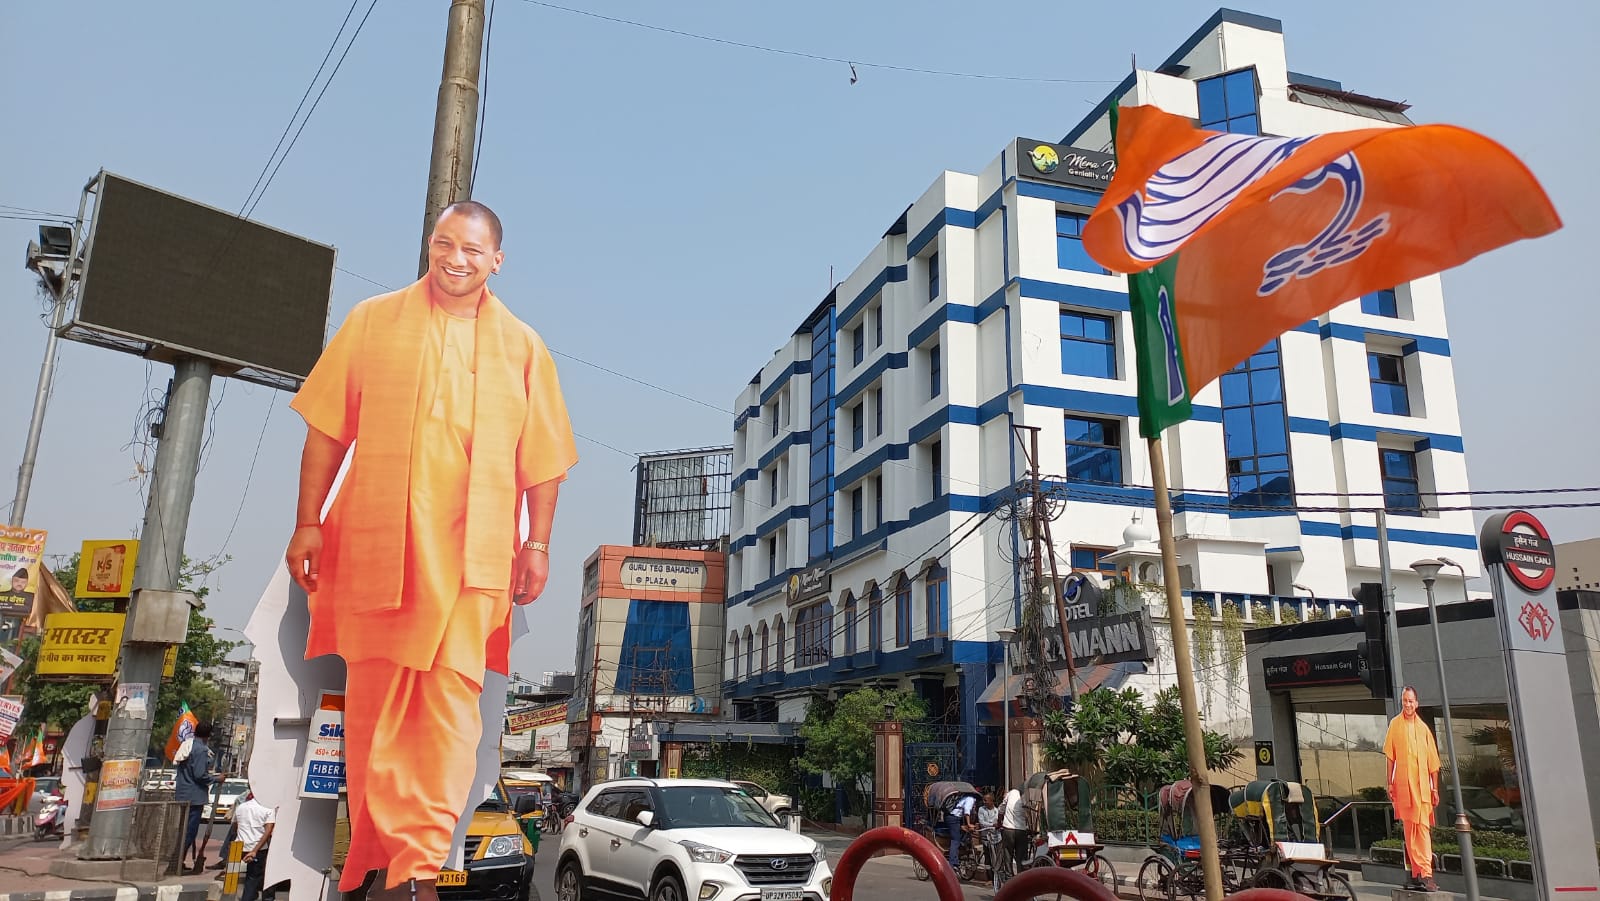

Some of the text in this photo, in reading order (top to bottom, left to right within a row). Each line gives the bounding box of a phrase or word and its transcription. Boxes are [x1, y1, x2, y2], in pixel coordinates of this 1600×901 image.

[1063, 153, 1099, 169] Mera
[1068, 168, 1099, 180] Geniality
[1505, 552, 1551, 565] HUSSAIN GANJ
[628, 563, 699, 574] GURU TEG BAHADUR
[645, 577, 669, 585] PLAZA
[50, 628, 114, 645] मास्टर
[1068, 621, 1141, 659] MANN
[313, 764, 340, 776] FIBER
